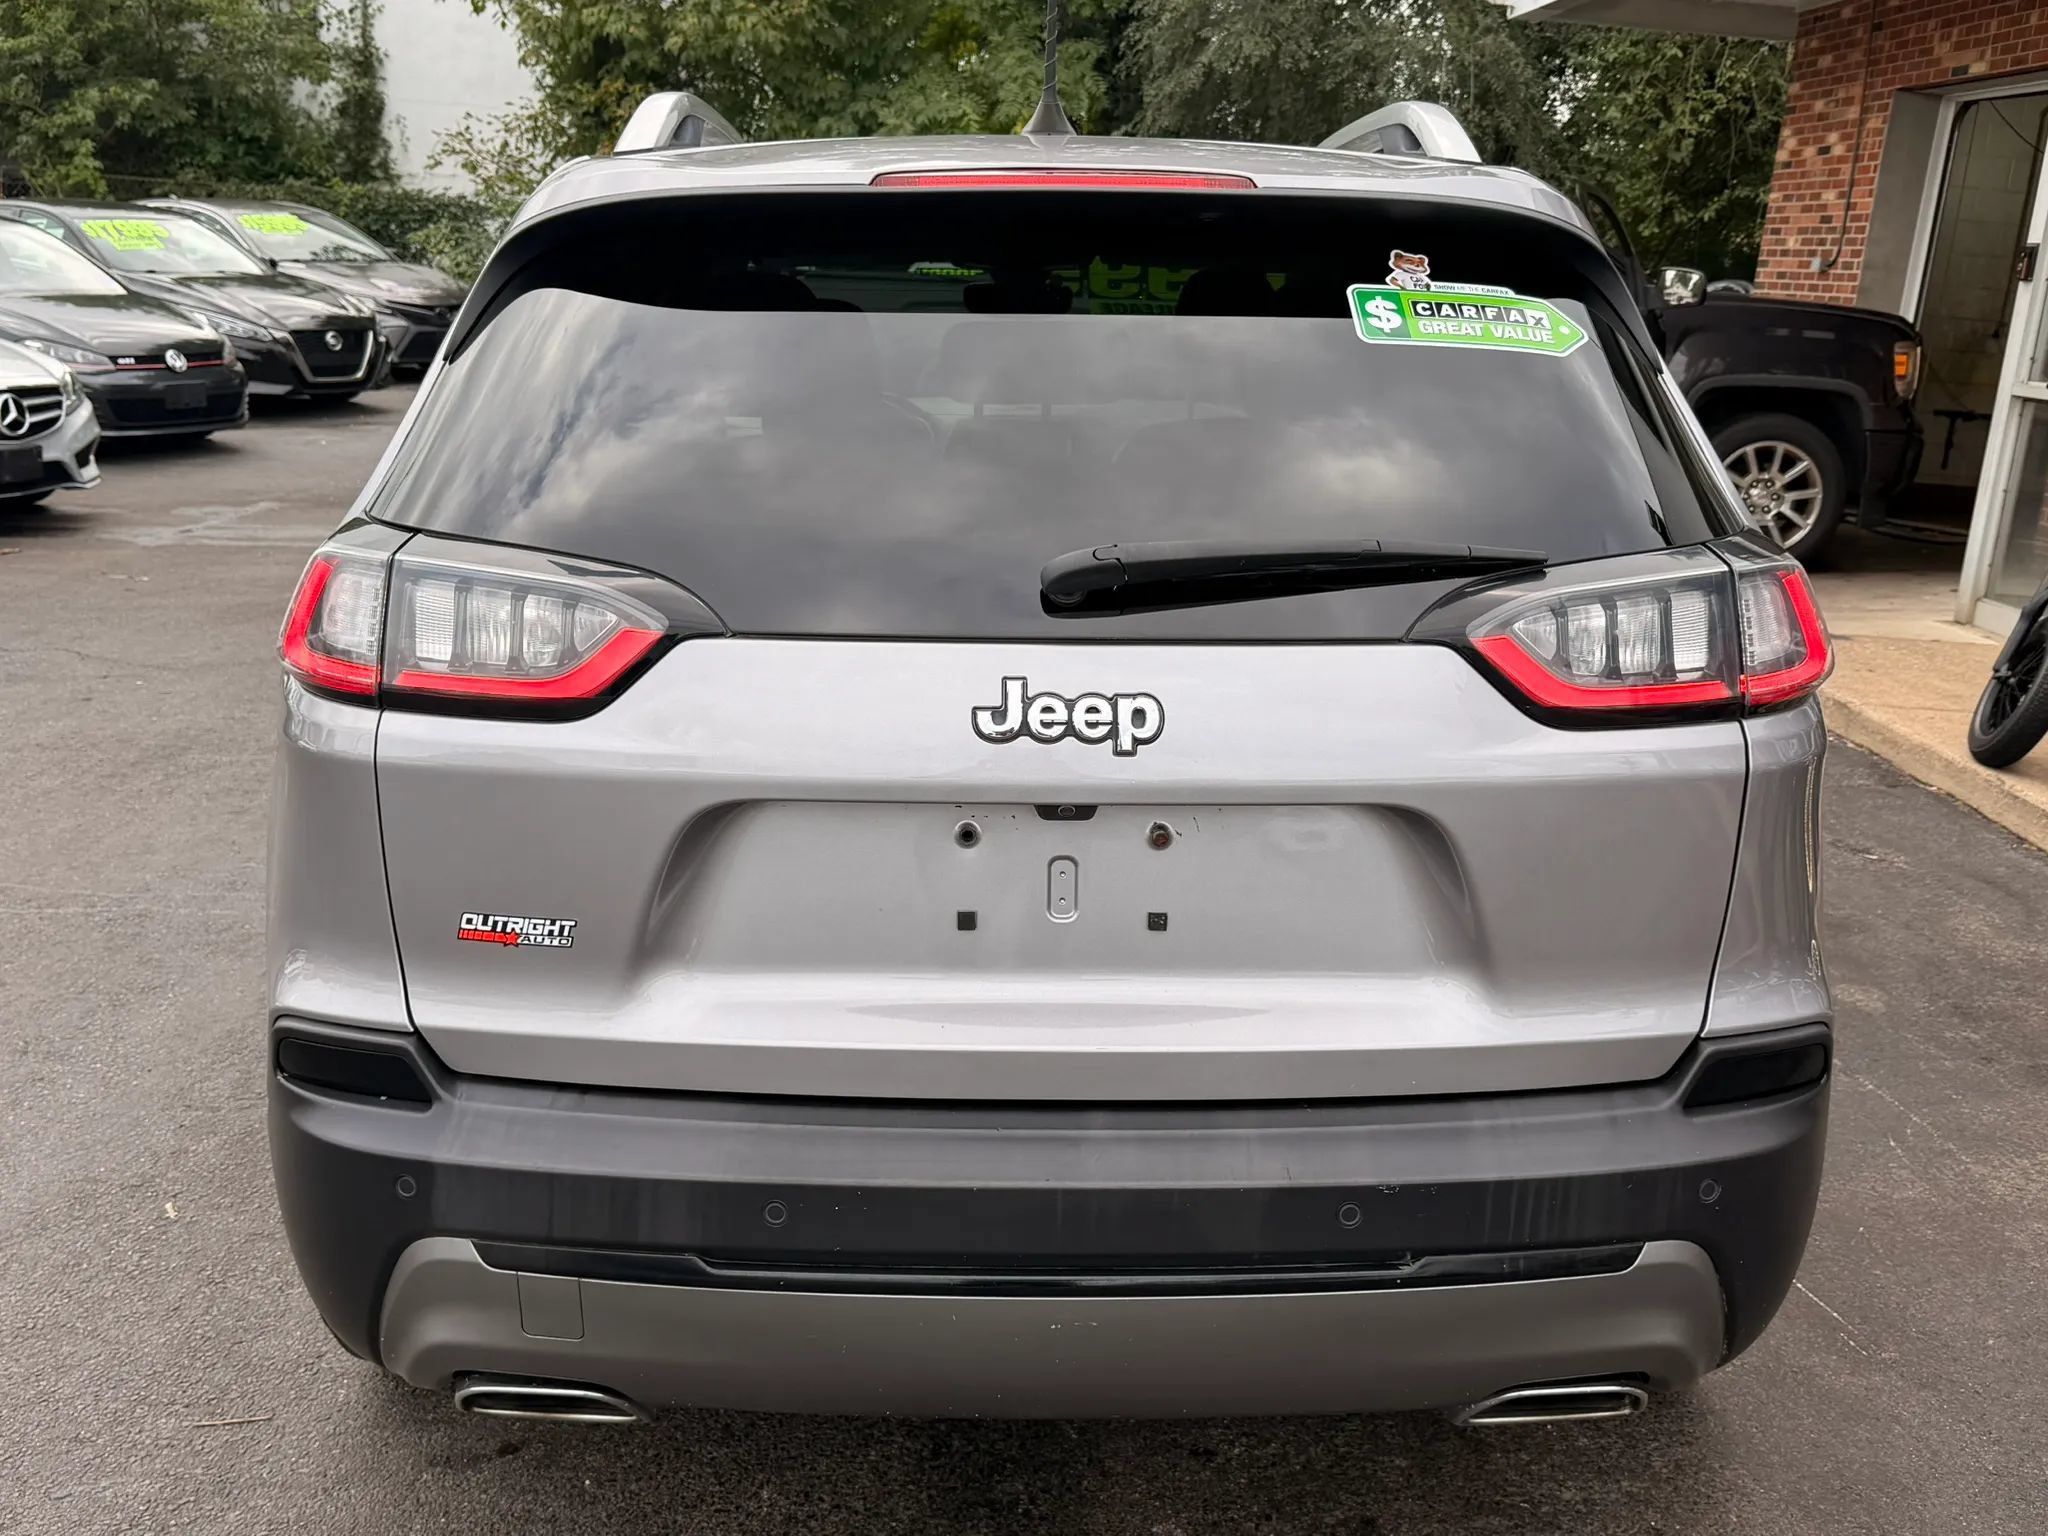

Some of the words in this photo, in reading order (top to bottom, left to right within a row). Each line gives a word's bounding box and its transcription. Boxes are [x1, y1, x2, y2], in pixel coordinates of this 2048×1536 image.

[1412, 302, 1548, 329] CARFAX
[1418, 320, 1484, 337] GREAT
[1490, 324, 1553, 344] VALUE
[972, 676, 1165, 757] Jeep
[460, 913, 576, 937] OUTRIGHT
[520, 935, 571, 946] AUTO
